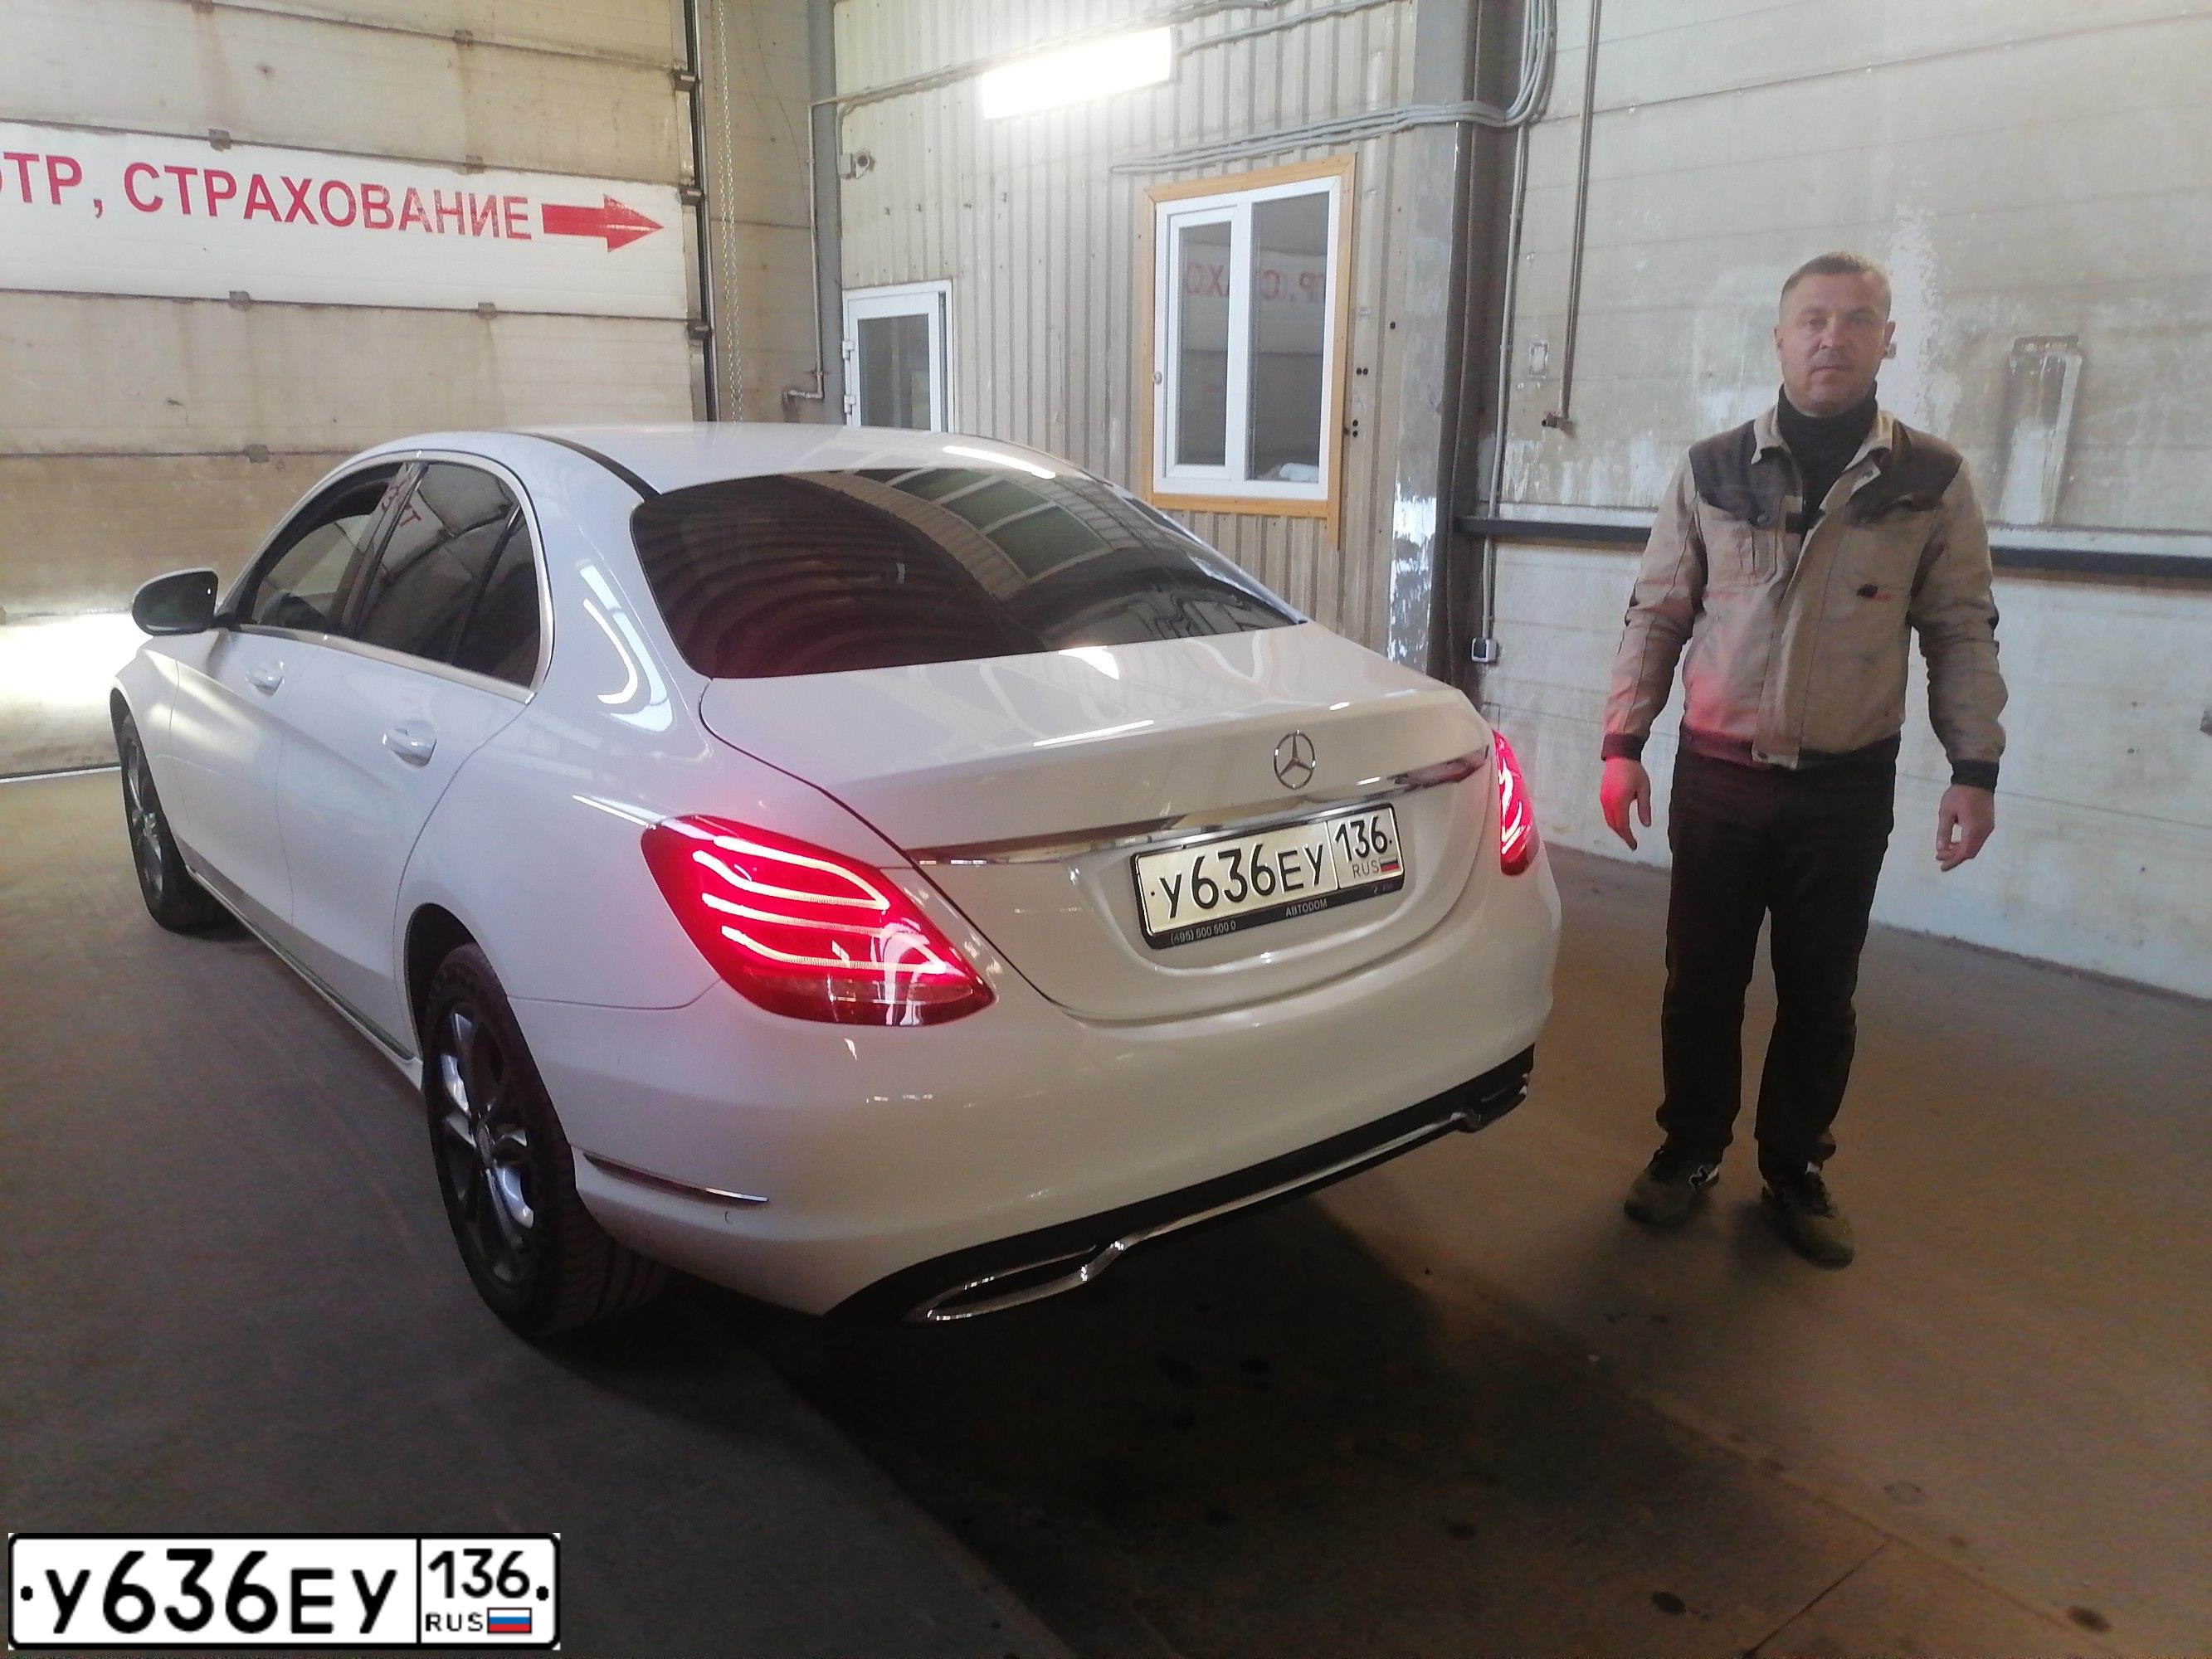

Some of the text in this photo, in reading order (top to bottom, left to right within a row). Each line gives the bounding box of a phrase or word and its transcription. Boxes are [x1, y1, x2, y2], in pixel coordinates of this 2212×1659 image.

[0, 152, 532, 239] ТР, СТРАХОВАНИЕ
[1157, 815, 1387, 919] У636ЕУ 136
[1352, 859, 1379, 878] RUS
